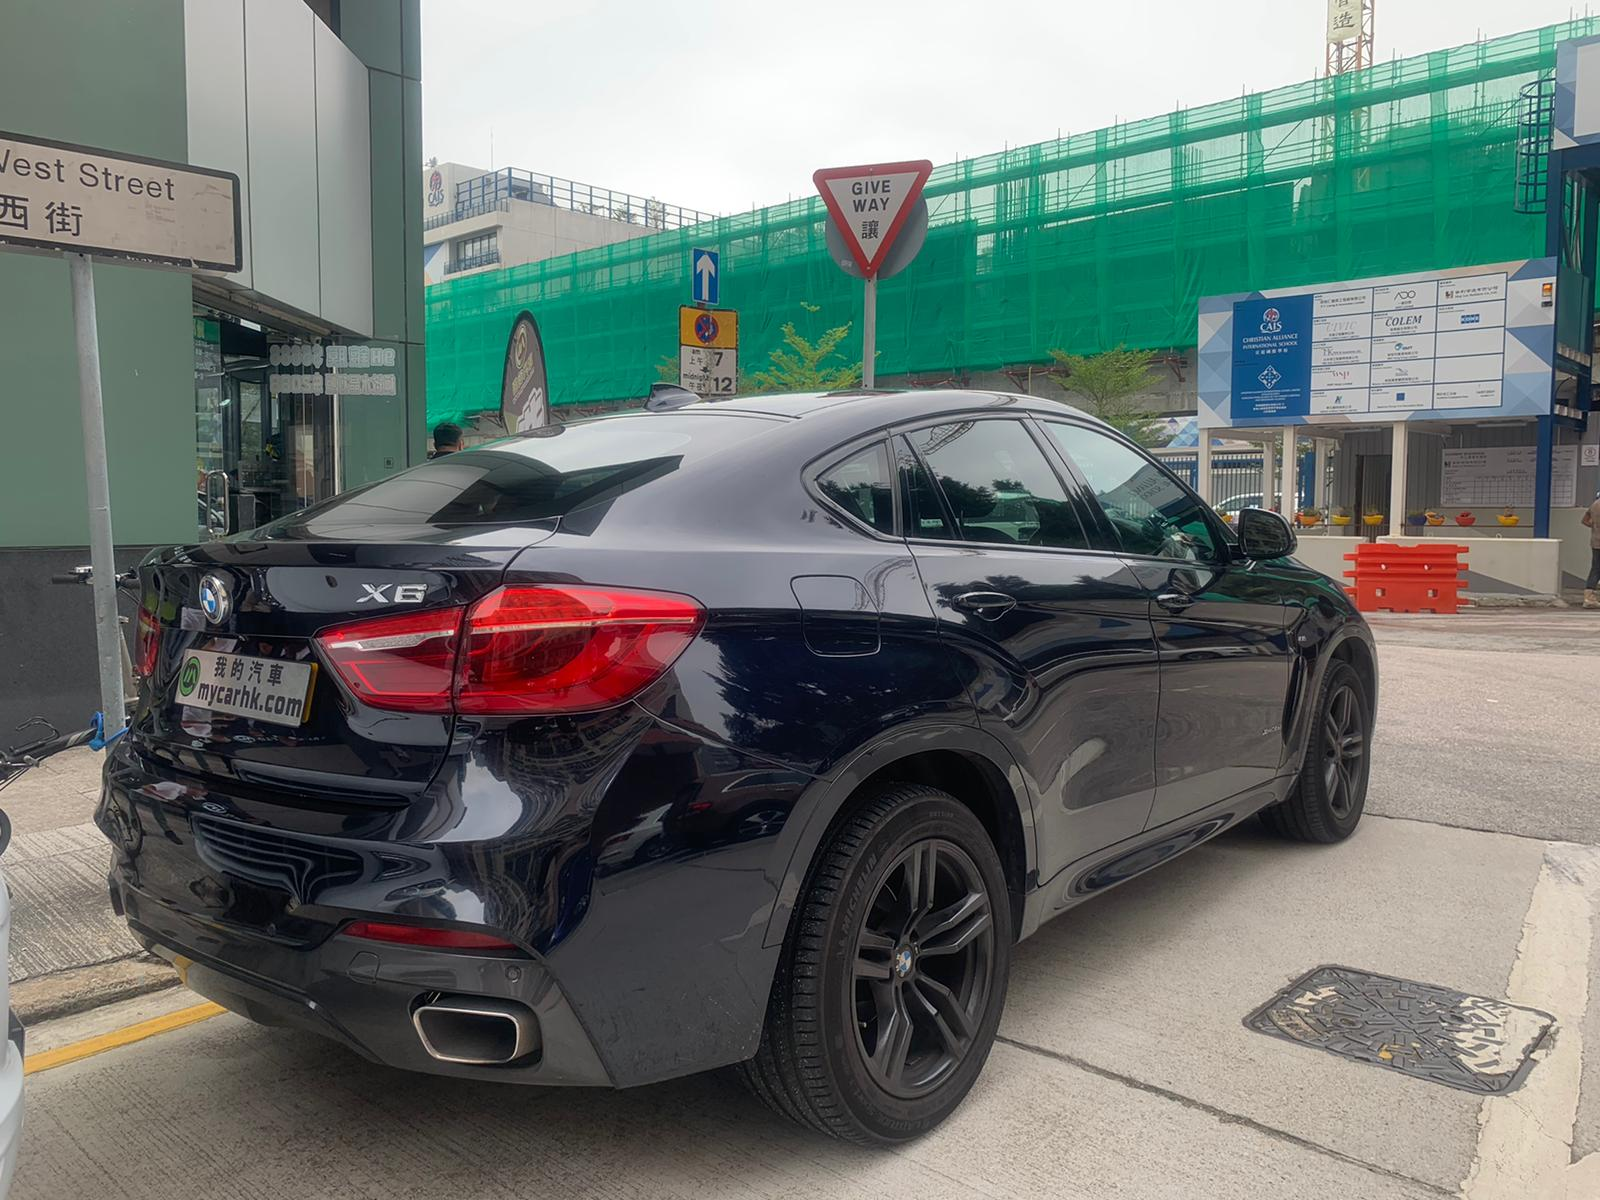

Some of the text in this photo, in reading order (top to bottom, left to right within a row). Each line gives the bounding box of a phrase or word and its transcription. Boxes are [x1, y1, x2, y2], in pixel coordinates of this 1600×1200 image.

[79, 163, 175, 201] Street
[852, 180, 891, 195] GIVE
[853, 197, 890, 213] WAY
[861, 219, 879, 239] 讓
[1260, 321, 1282, 332] CAIS
[1386, 315, 1423, 327] COLEM
[713, 351, 724, 367] 7
[713, 376, 732, 392] 12
[357, 583, 429, 603] X6
[214, 656, 283, 686] 我的汽車
[198, 682, 302, 718] mycarhk.com
